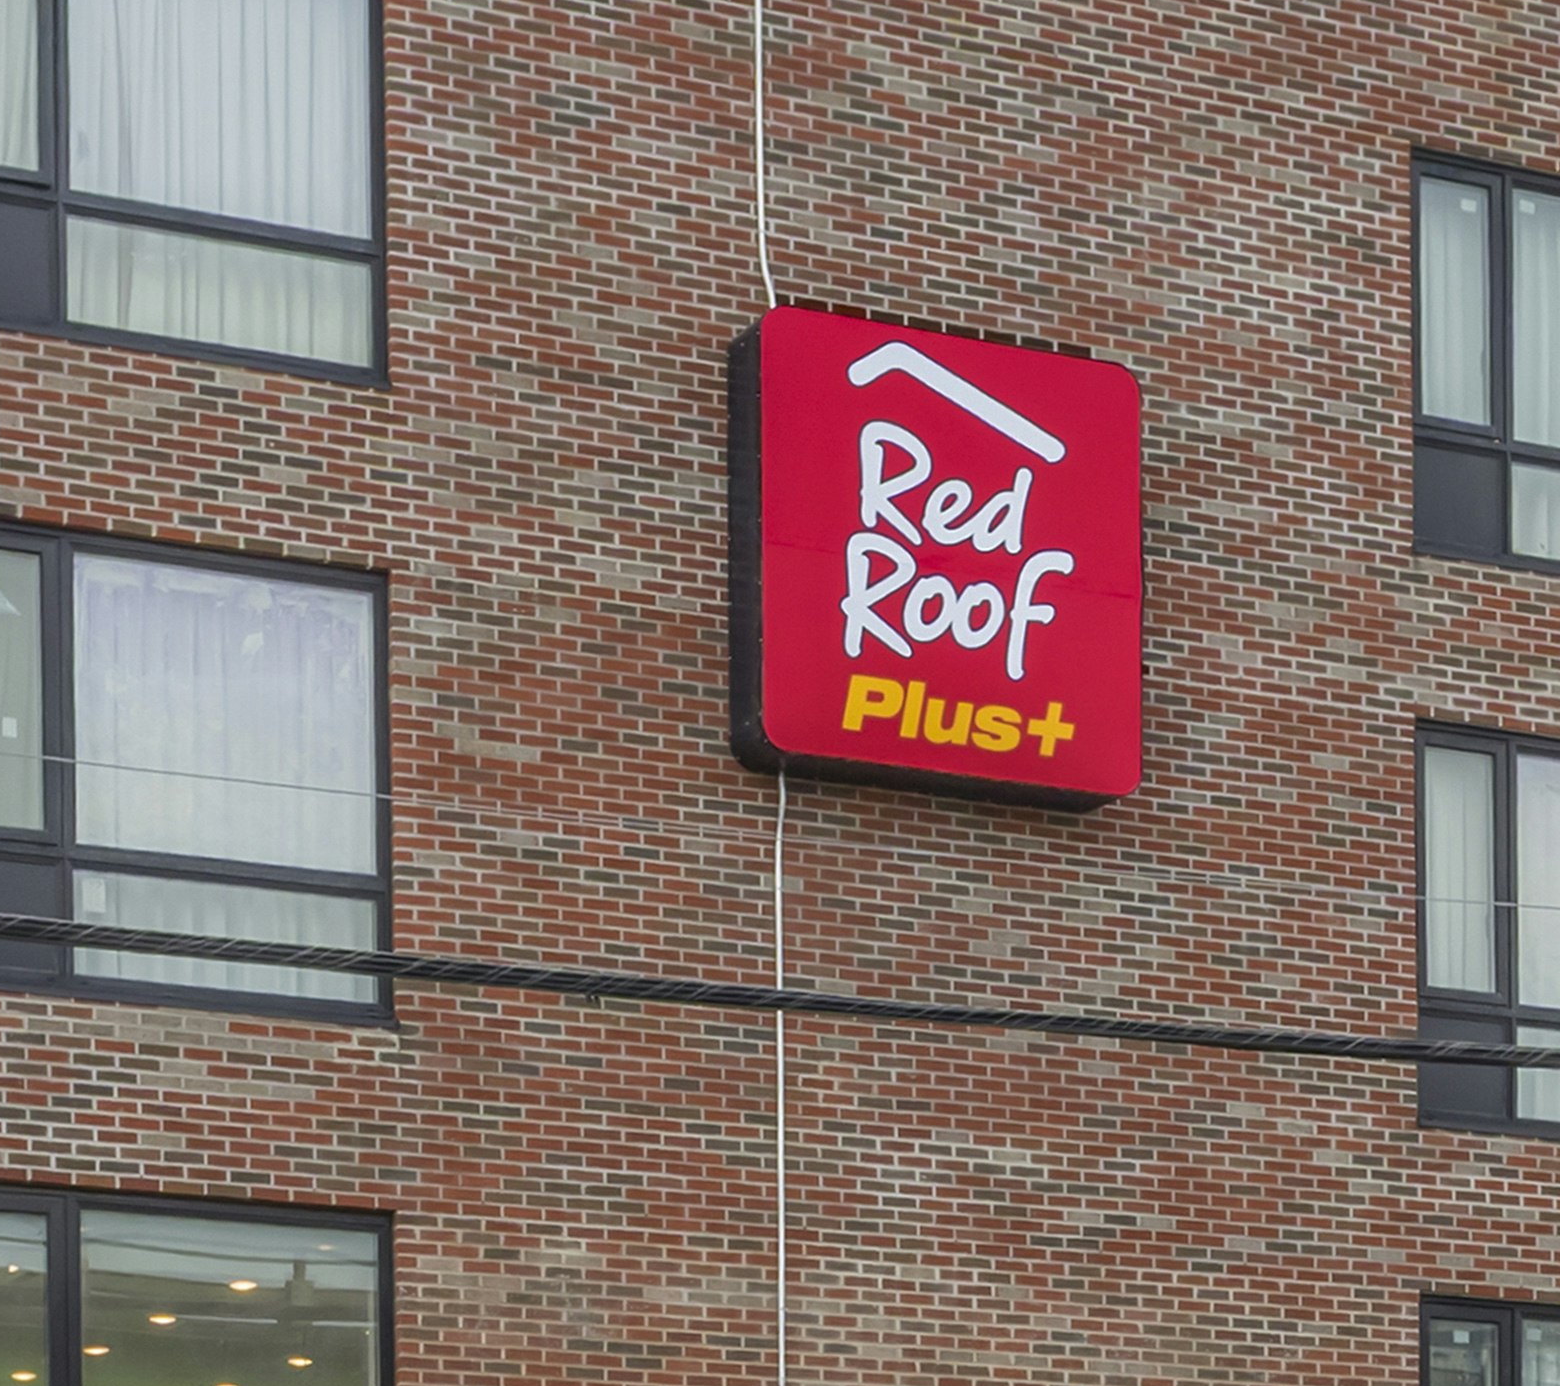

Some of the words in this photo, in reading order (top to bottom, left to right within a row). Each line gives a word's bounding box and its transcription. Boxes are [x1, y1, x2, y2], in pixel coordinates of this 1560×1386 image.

[858, 420, 1033, 554] Red
[840, 532, 1075, 680] Roof
[842, 674, 1075, 757] Plus+
